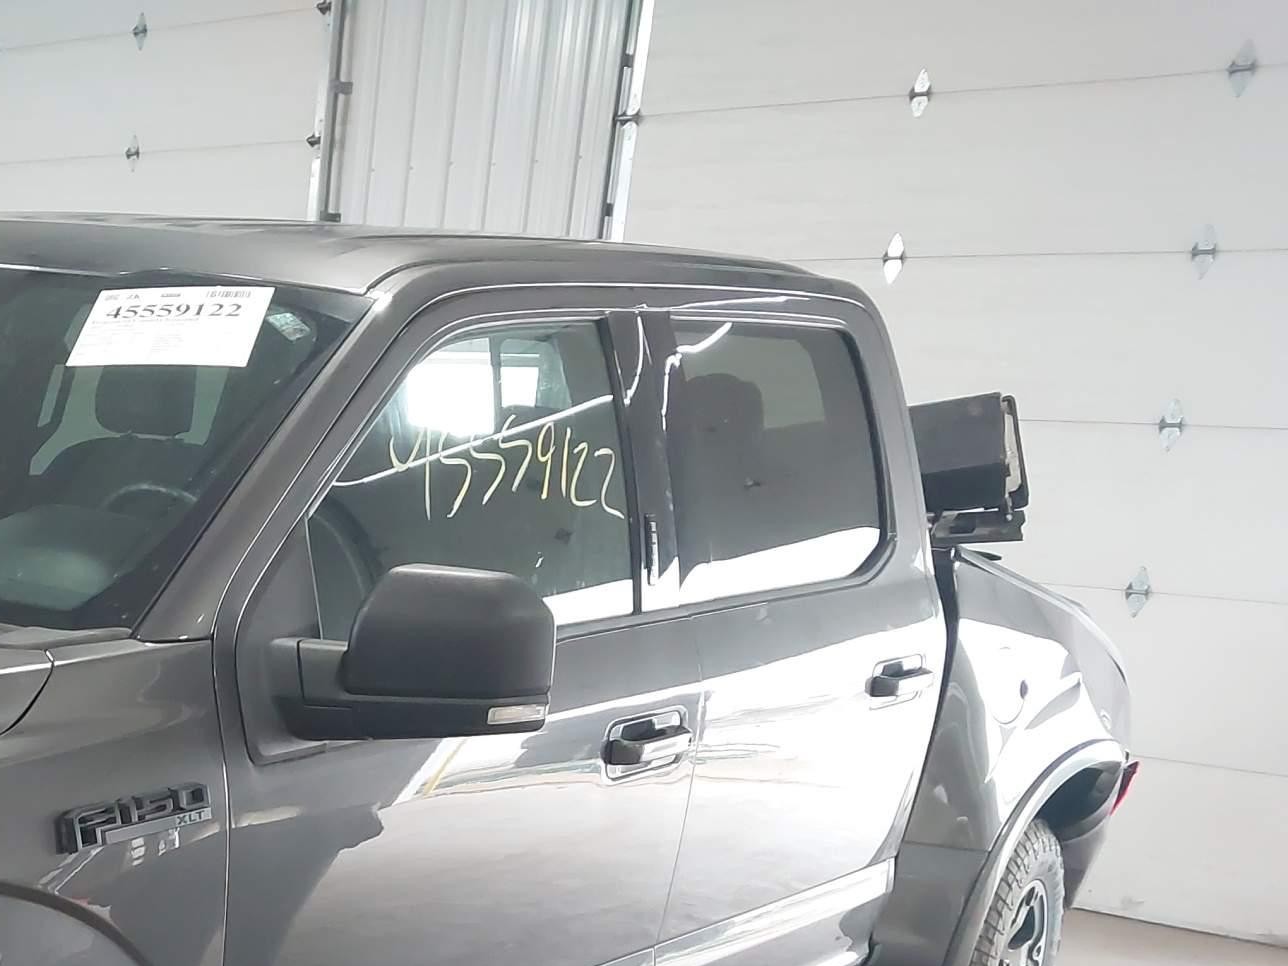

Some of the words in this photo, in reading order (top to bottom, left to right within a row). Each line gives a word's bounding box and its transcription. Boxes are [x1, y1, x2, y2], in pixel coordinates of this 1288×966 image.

[105, 303, 243, 319] 45559122
[389, 414, 625, 521] 45559122
[176, 809, 207, 826] XLT
